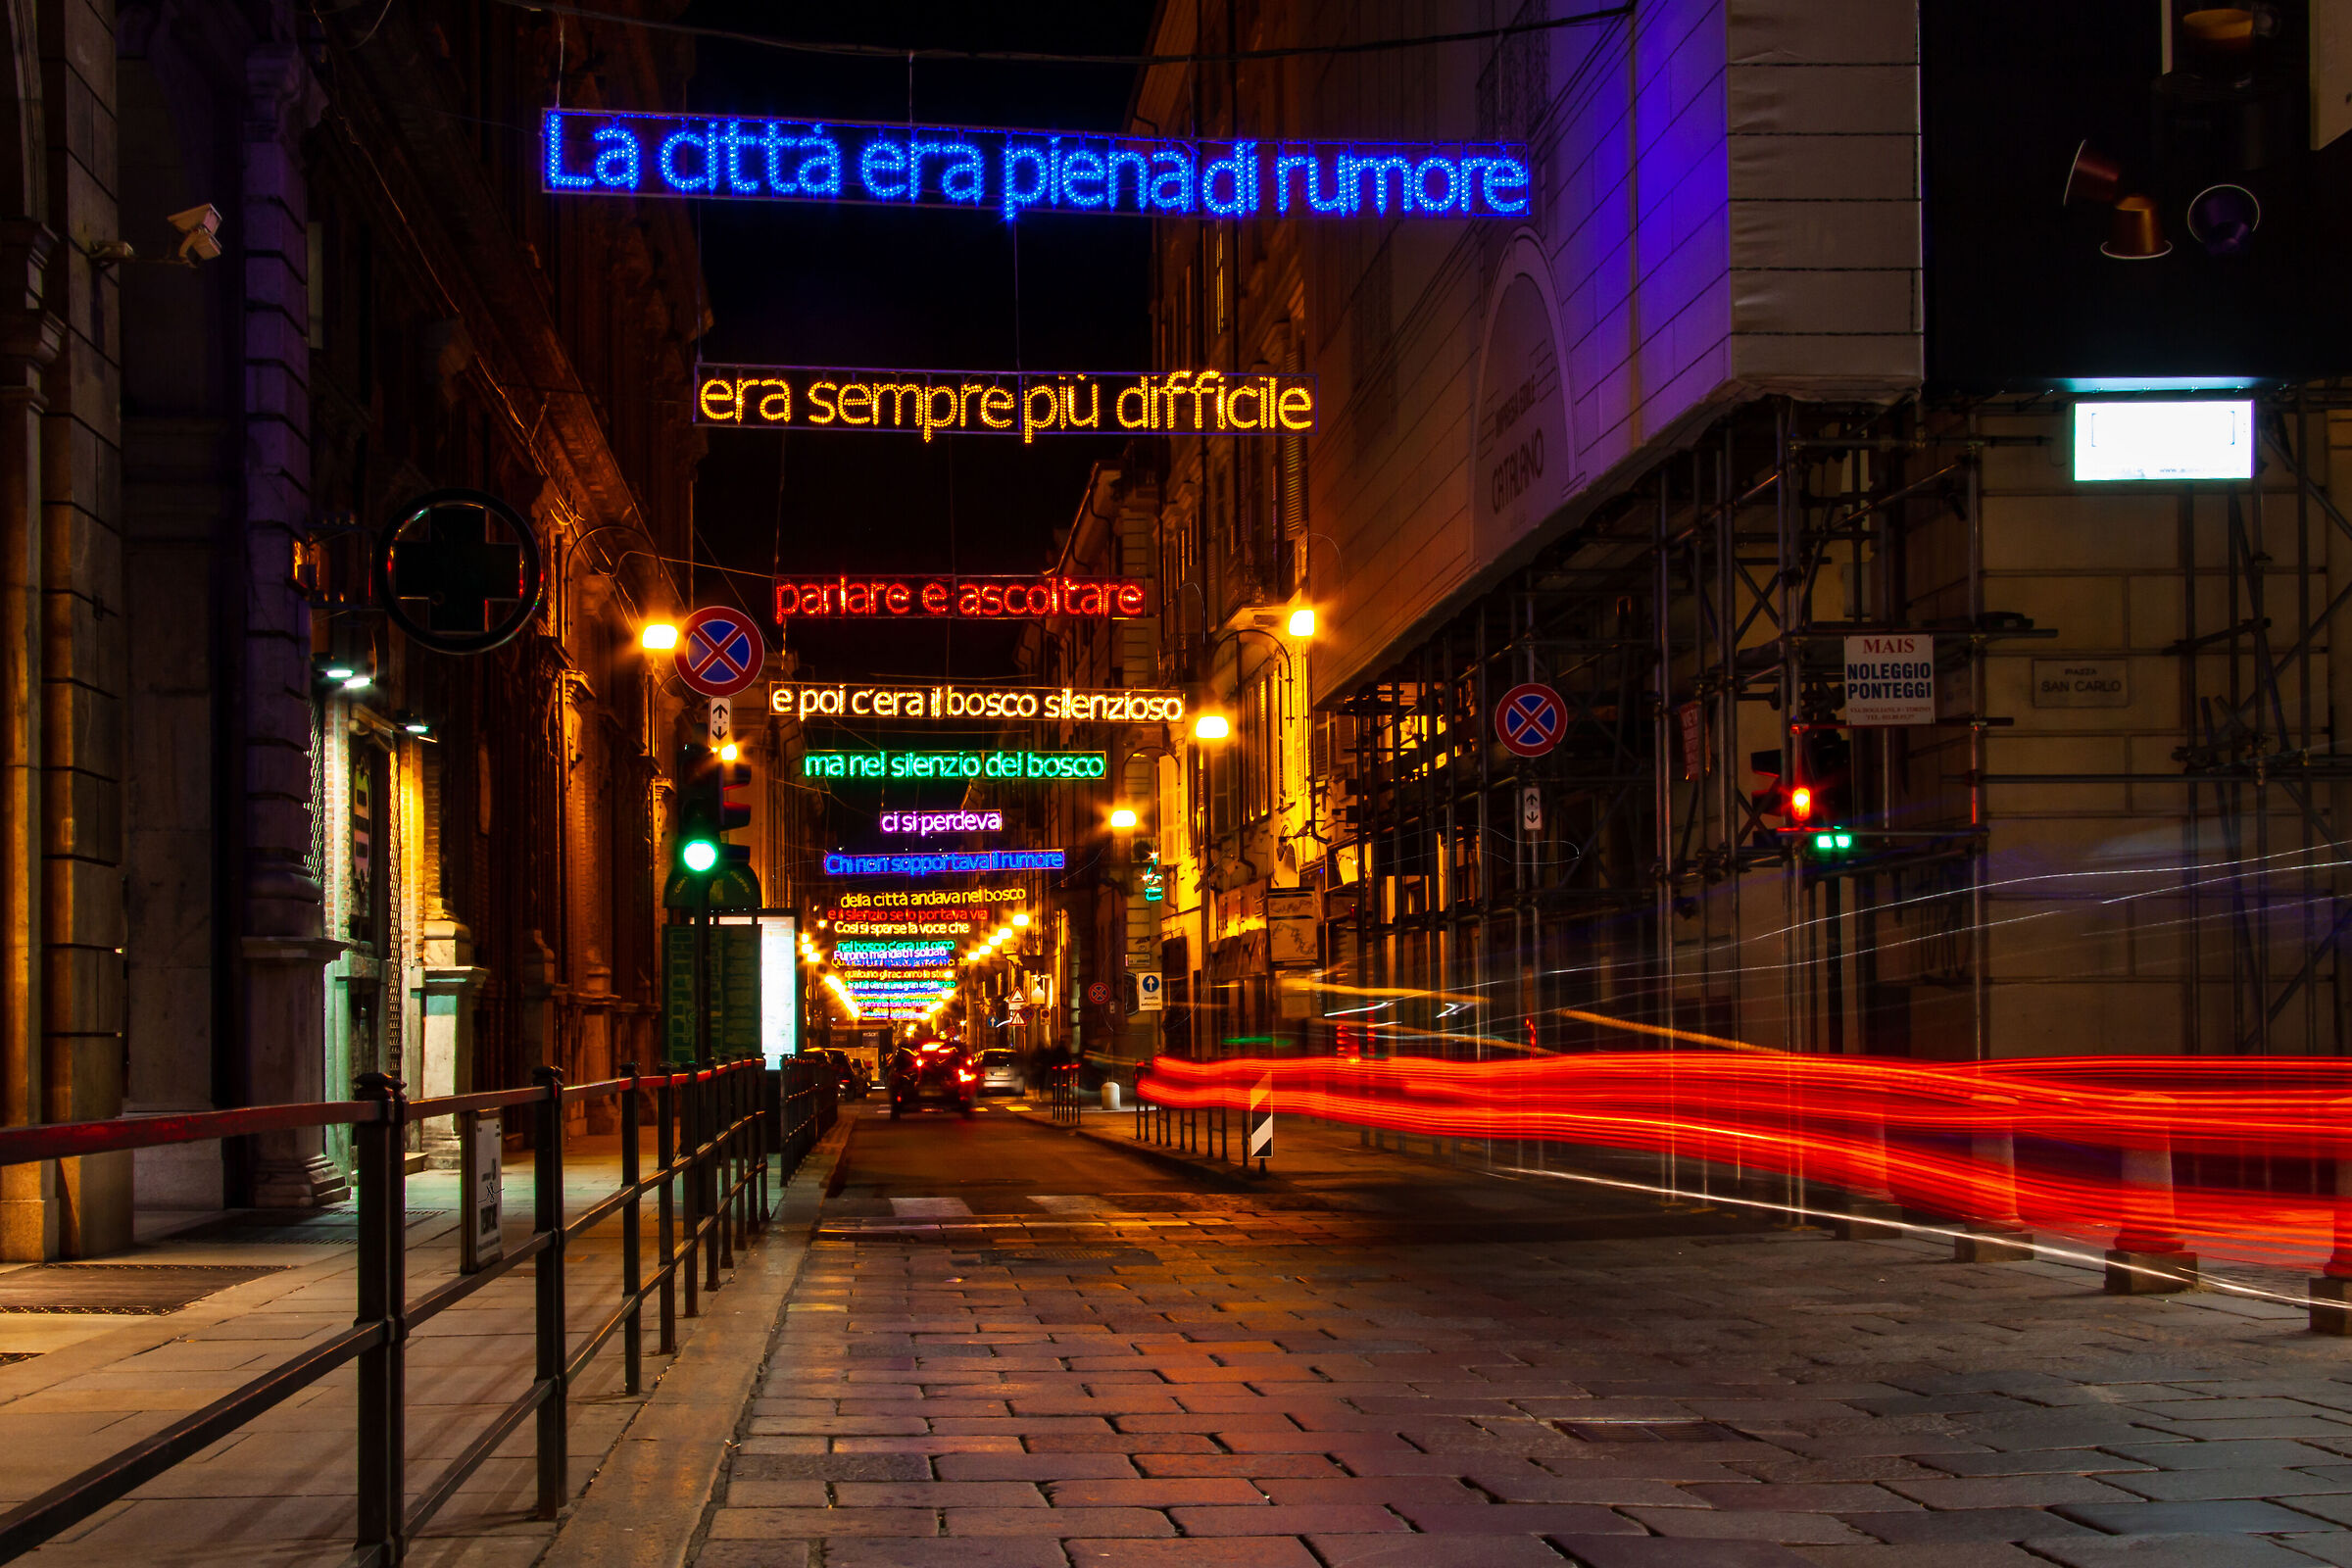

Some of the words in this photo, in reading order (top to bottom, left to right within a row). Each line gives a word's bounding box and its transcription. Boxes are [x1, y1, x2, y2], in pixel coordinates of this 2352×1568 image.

[549, 113, 639, 189] La
[660, 118, 841, 194] città
[860, 141, 984, 207] era
[1002, 136, 1192, 221] piena
[1201, 140, 1259, 216] di
[1275, 153, 1529, 217] rumore
[699, 377, 791, 422] era
[808, 380, 1014, 443] sempre
[1024, 373, 1099, 444] più
[1116, 369, 1314, 430] difficile
[775, 575, 910, 624] parlare
[921, 582, 948, 614] e
[958, 576, 1144, 616] ascoltare
[1863, 637, 1915, 655] MAIS
[1846, 662, 1932, 680] NOLEGGIO
[1847, 681, 1932, 700] PONTEGGI
[2041, 680, 2070, 692] SAN
[2075, 680, 2122, 692] CARLO
[771, 687, 793, 712] e
[799, 683, 847, 722] poi
[851, 688, 924, 717] c'era
[930, 686, 942, 717] il
[946, 684, 1039, 717] bosco
[1044, 686, 1184, 721] silenzioso
[804, 754, 844, 777] ma
[850, 751, 886, 777] nel
[891, 751, 981, 778] silenzio
[985, 750, 1022, 778] del
[1026, 752, 1105, 779] bosco
[882, 811, 899, 832] ci
[902, 811, 918, 832] si
[919, 810, 1002, 837] perdeva
[825, 854, 854, 873] Chi
[858, 858, 889, 872] non
[891, 854, 991, 877] sopportava
[1000, 852, 1064, 869] rumore
[840, 892, 871, 908] della
[910, 890, 960, 906] andava
[962, 888, 982, 904] nel
[984, 888, 1026, 903] bosco
